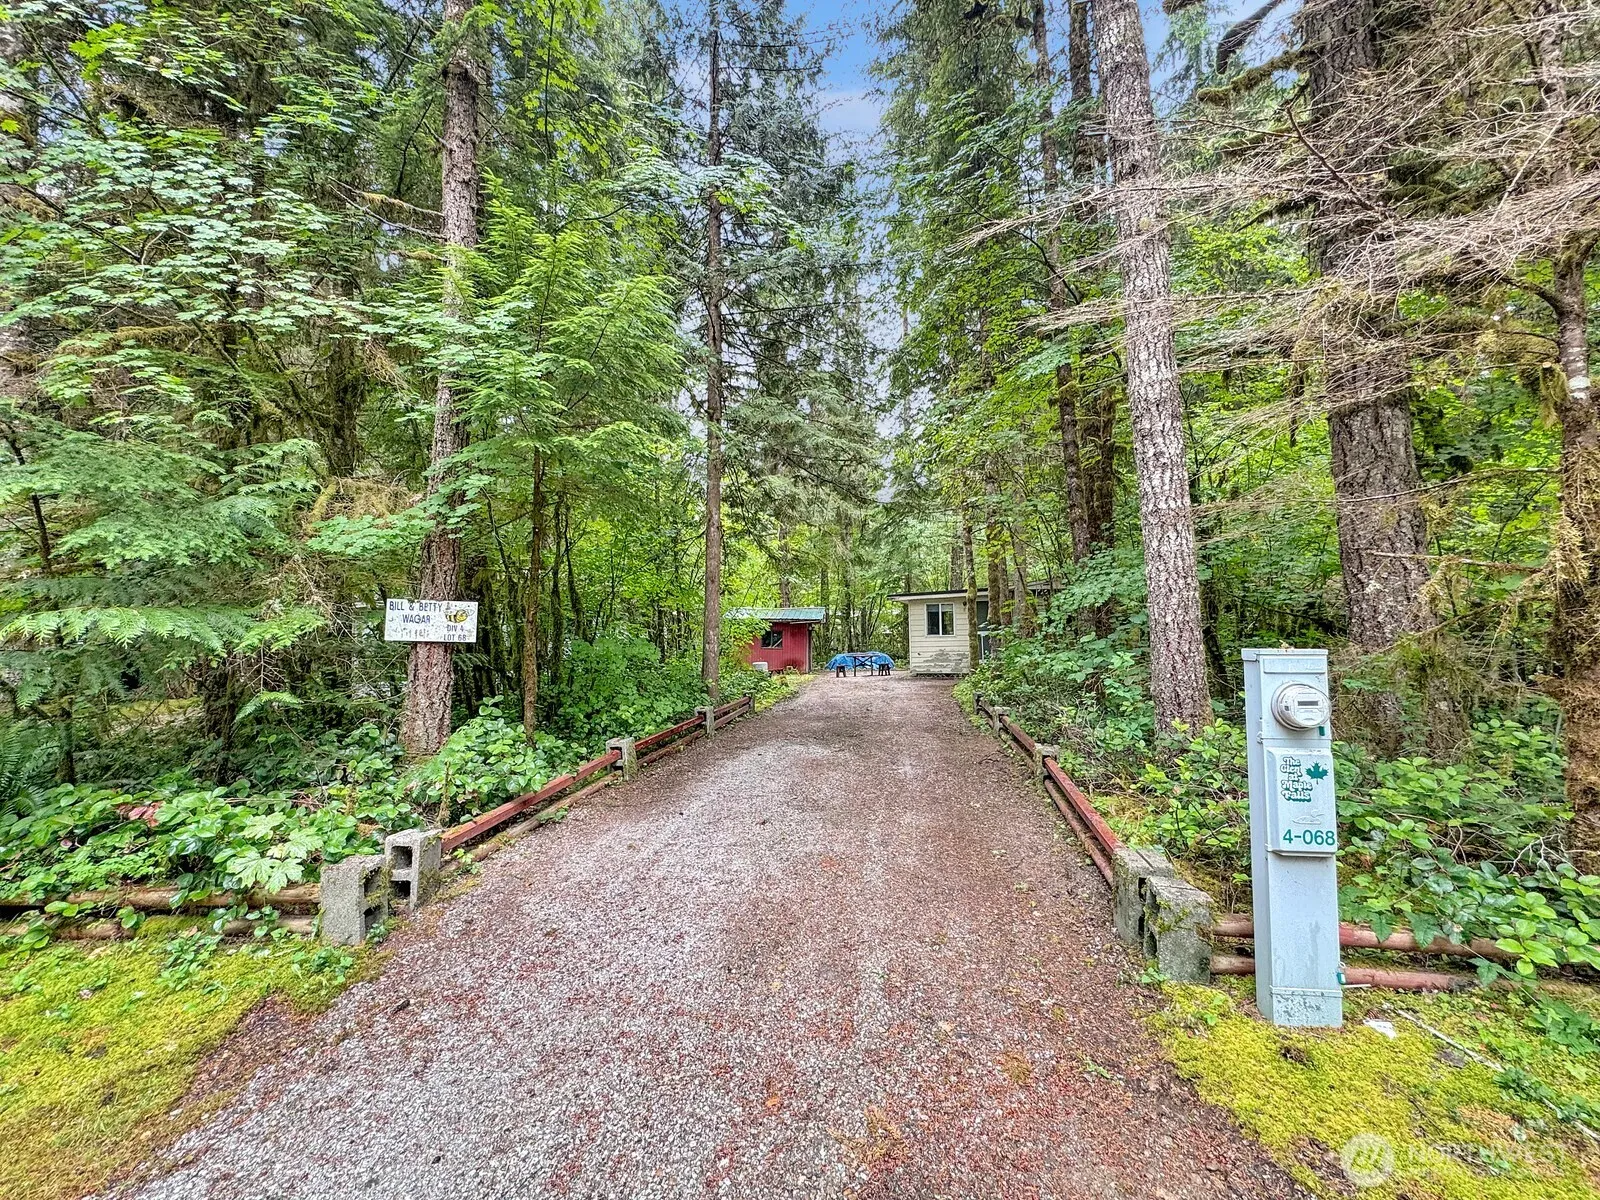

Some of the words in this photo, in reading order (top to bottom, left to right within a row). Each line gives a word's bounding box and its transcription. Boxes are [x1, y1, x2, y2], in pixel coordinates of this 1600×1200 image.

[389, 601, 405, 611] BILL
[418, 602, 443, 612] BETTY
[402, 614, 431, 624] WAGAR
[1283, 756, 1301, 767] The
[1280, 764, 1303, 777] Glen
[1288, 774, 1300, 782] at
[1281, 780, 1313, 792] Maple
[1281, 790, 1312, 802] Falls
[1282, 828, 1336, 846] 4-068
